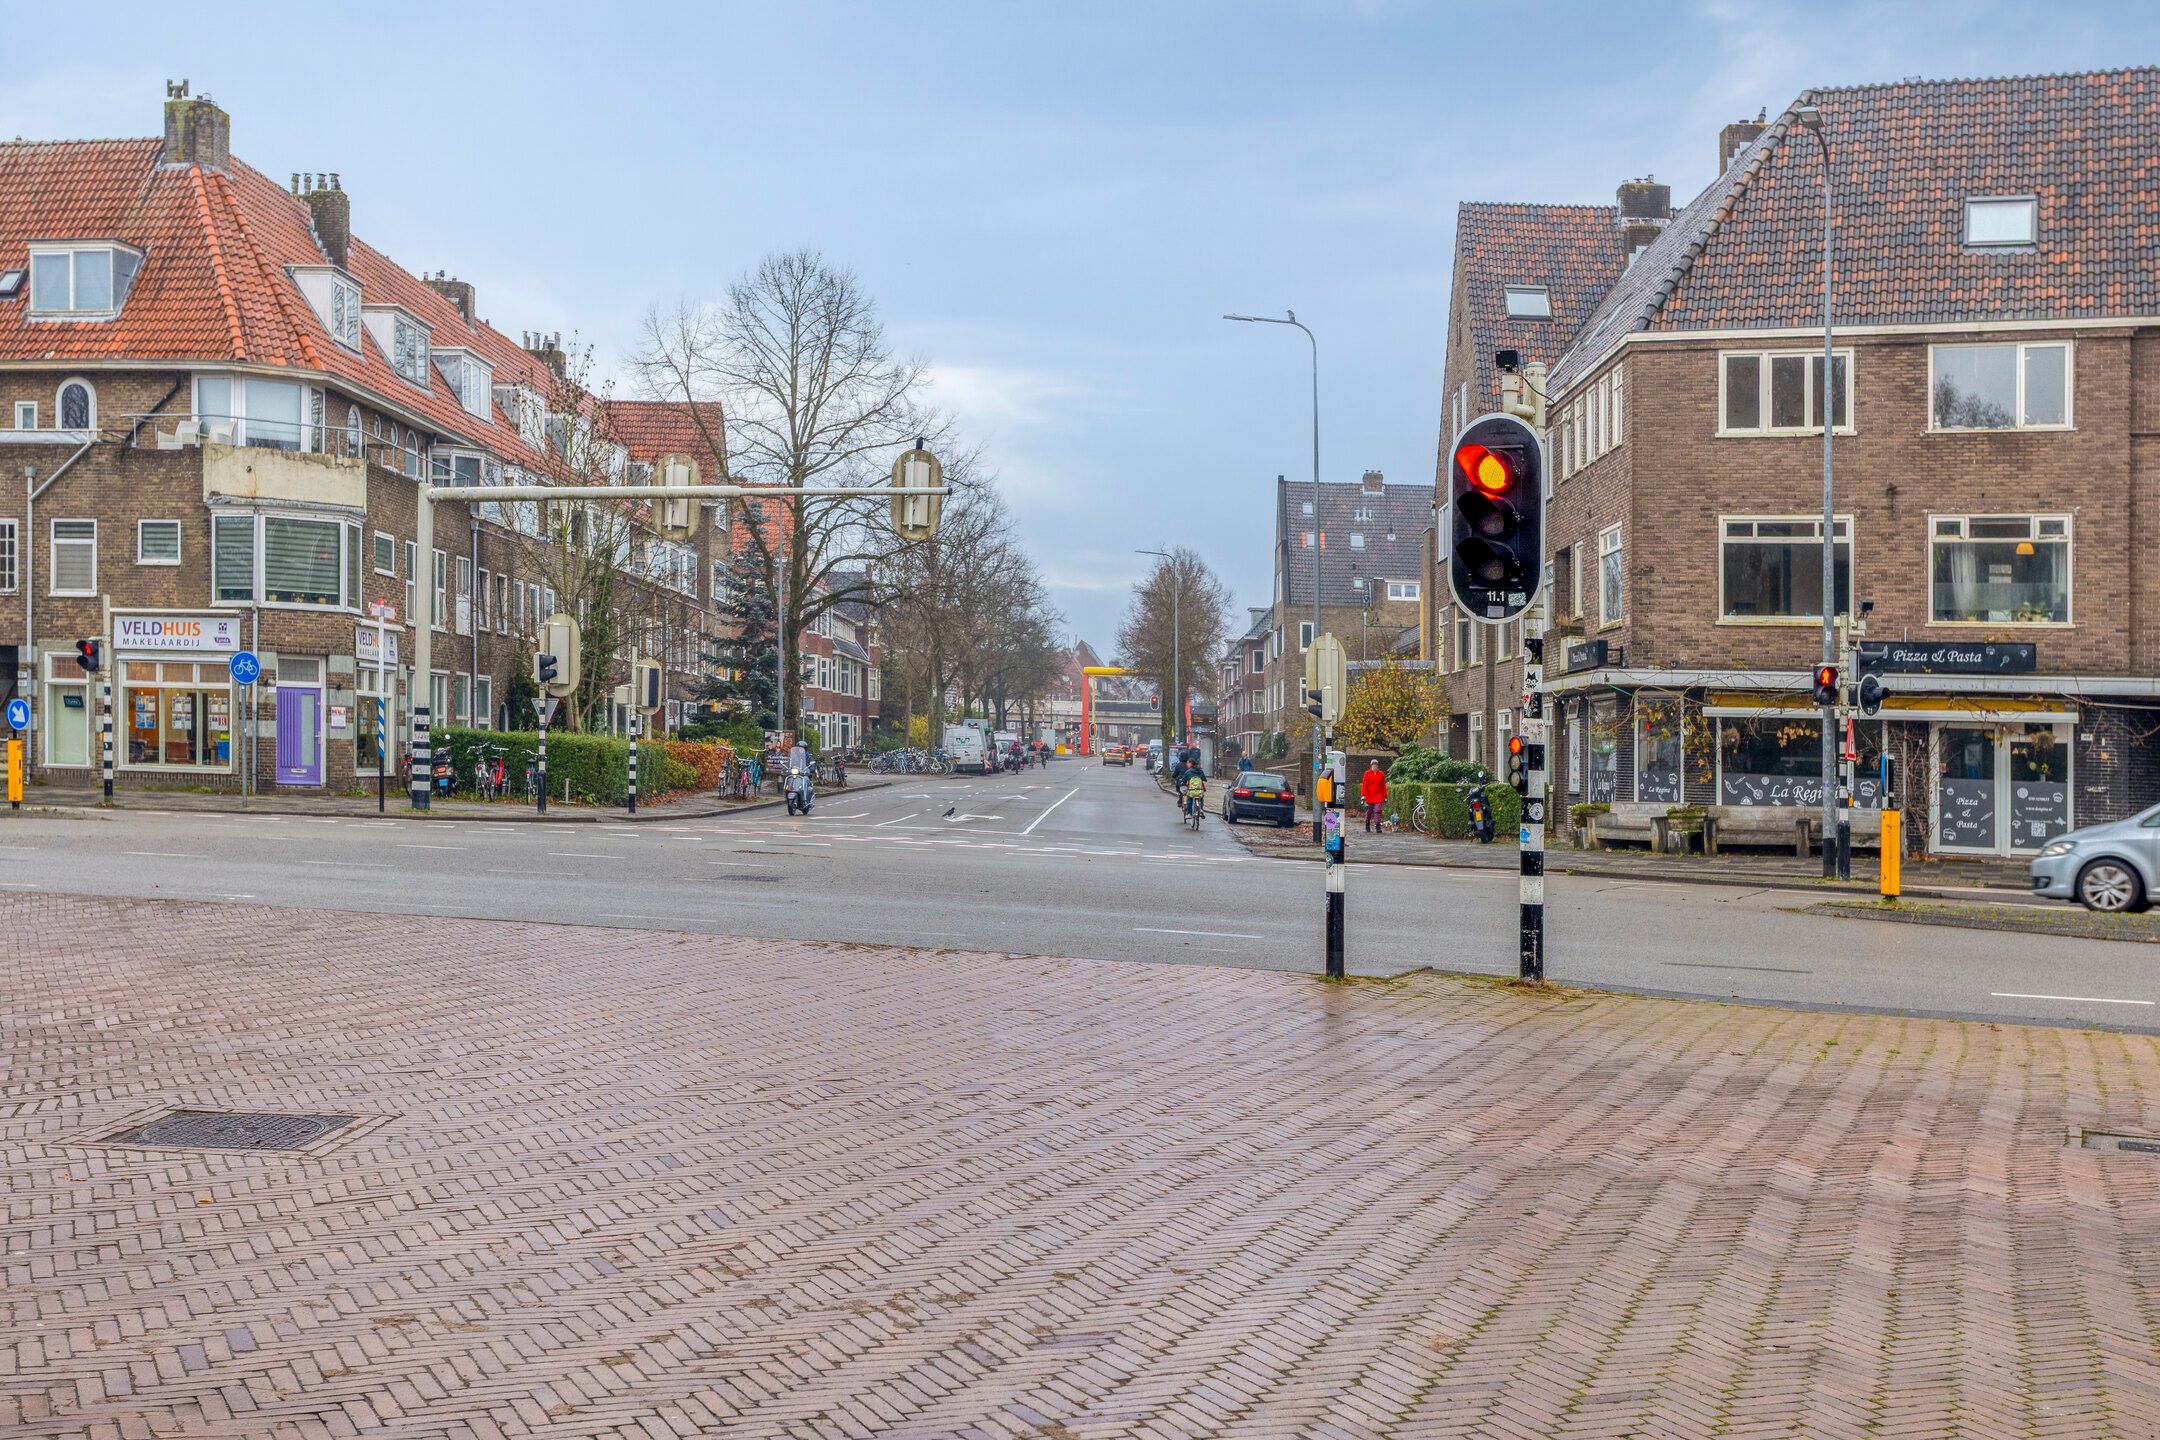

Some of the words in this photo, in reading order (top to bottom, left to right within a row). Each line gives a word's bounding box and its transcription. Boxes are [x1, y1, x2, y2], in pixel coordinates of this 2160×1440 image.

[1487, 590, 1505, 602] 11.1
[122, 621, 201, 636] VELDHUIS
[122, 638, 200, 647] MAKELAARDIJ
[1893, 649, 1928, 662] Pizza
[1947, 650, 1982, 663] Pasta
[1770, 785, 1789, 798] La
[1955, 797, 1979, 806] Pizza
[1956, 820, 1978, 829] Pasta
